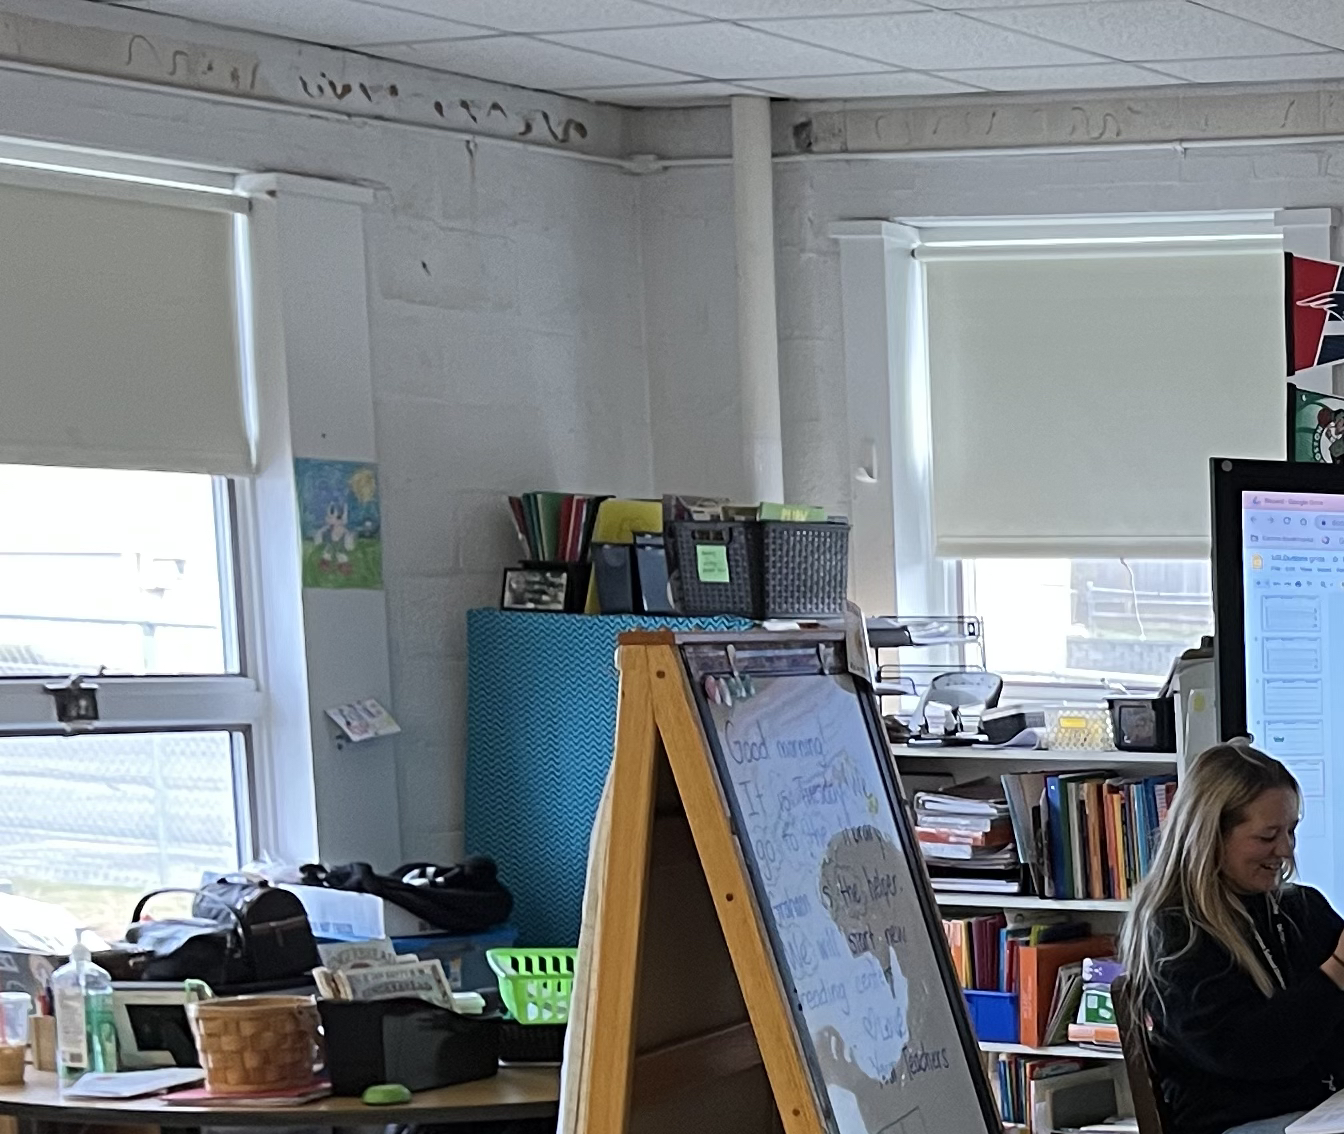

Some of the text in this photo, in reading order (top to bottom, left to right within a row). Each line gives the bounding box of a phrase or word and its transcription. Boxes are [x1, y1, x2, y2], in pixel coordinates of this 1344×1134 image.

[725, 718, 768, 764] Good
[739, 780, 767, 816] It
[755, 839, 776, 881] go
[782, 828, 800, 851] to
[838, 872, 861, 905] the
[784, 925, 908, 971] We will start new
[801, 978, 852, 1016] reading
[902, 1044, 950, 1081] Teachers
